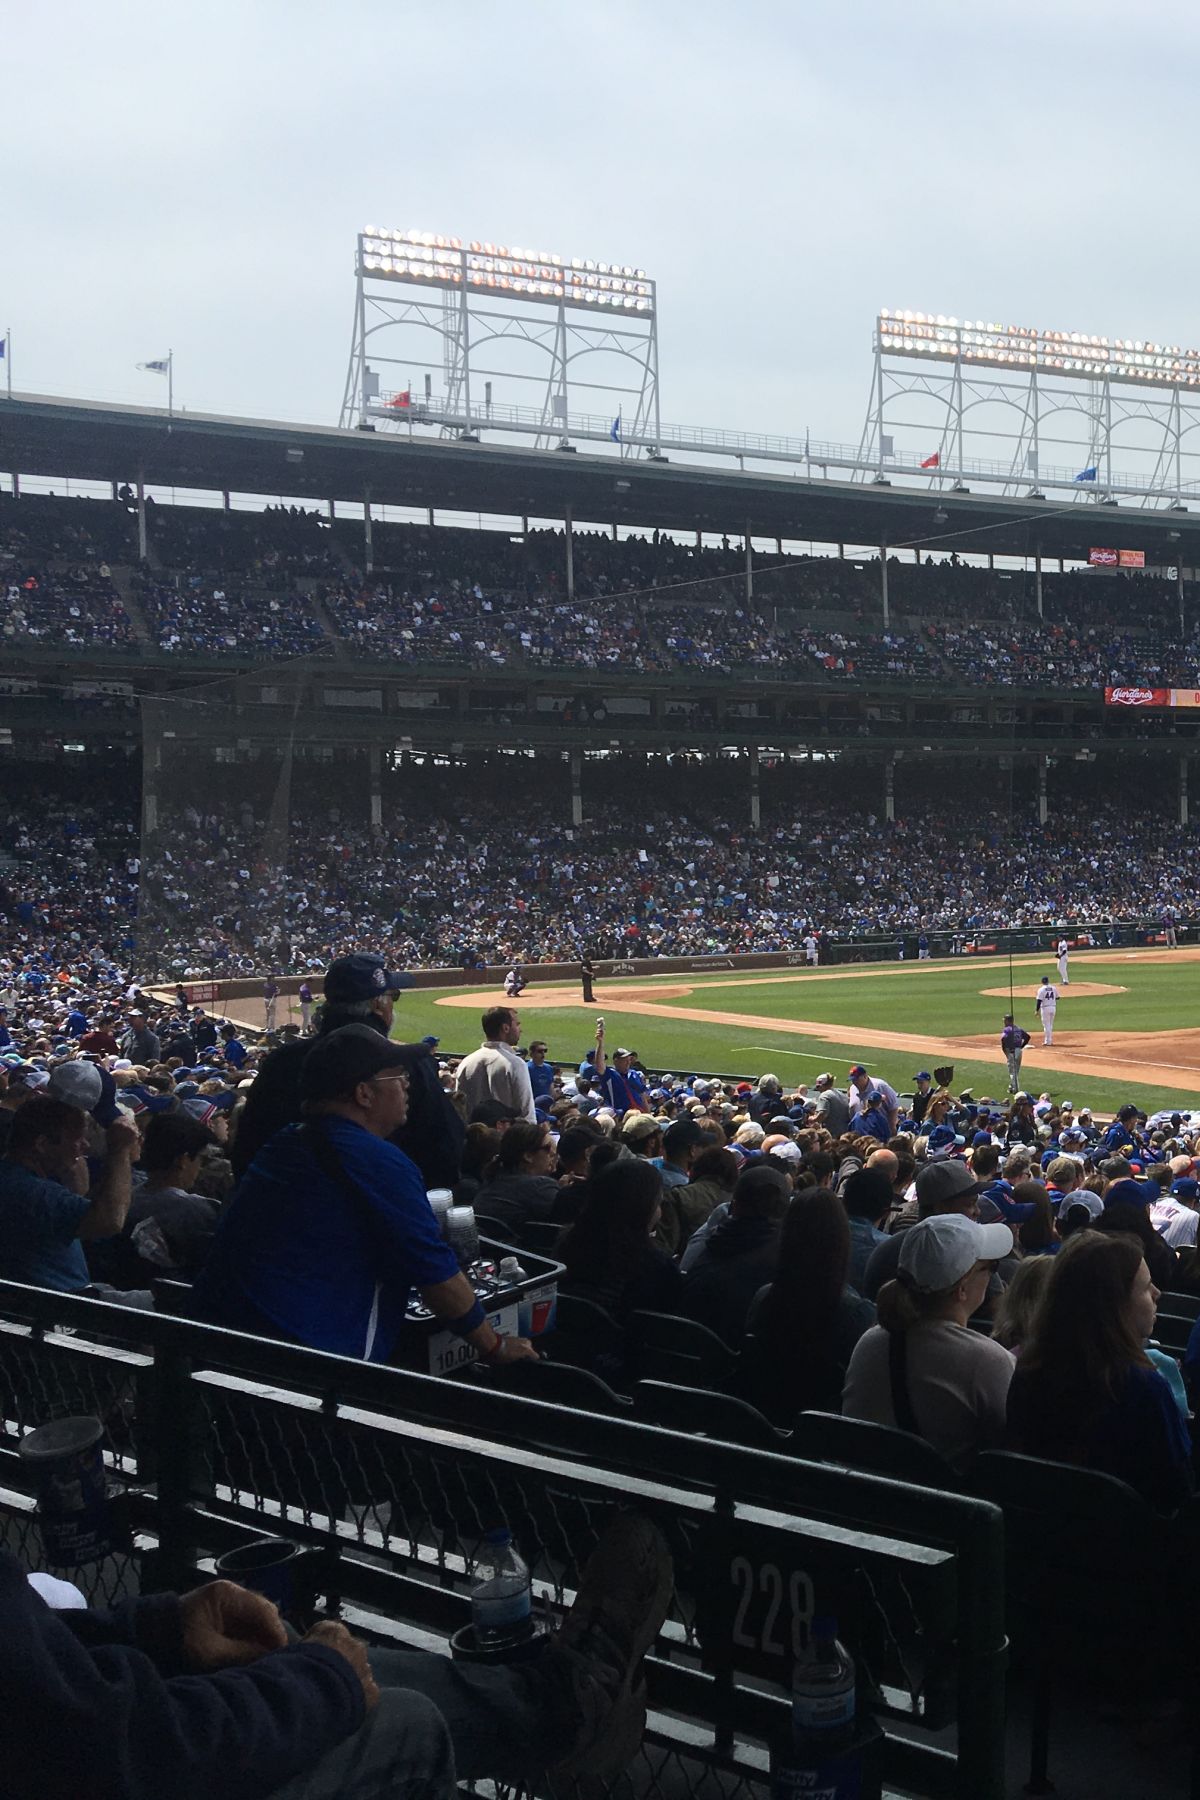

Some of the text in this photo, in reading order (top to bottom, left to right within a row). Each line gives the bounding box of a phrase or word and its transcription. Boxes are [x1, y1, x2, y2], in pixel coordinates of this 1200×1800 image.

[1111, 688, 1153, 704] Giordano's
[1045, 991, 1054, 1001] 44
[437, 1341, 475, 1369] 10.00
[730, 1555, 816, 1659] 228
